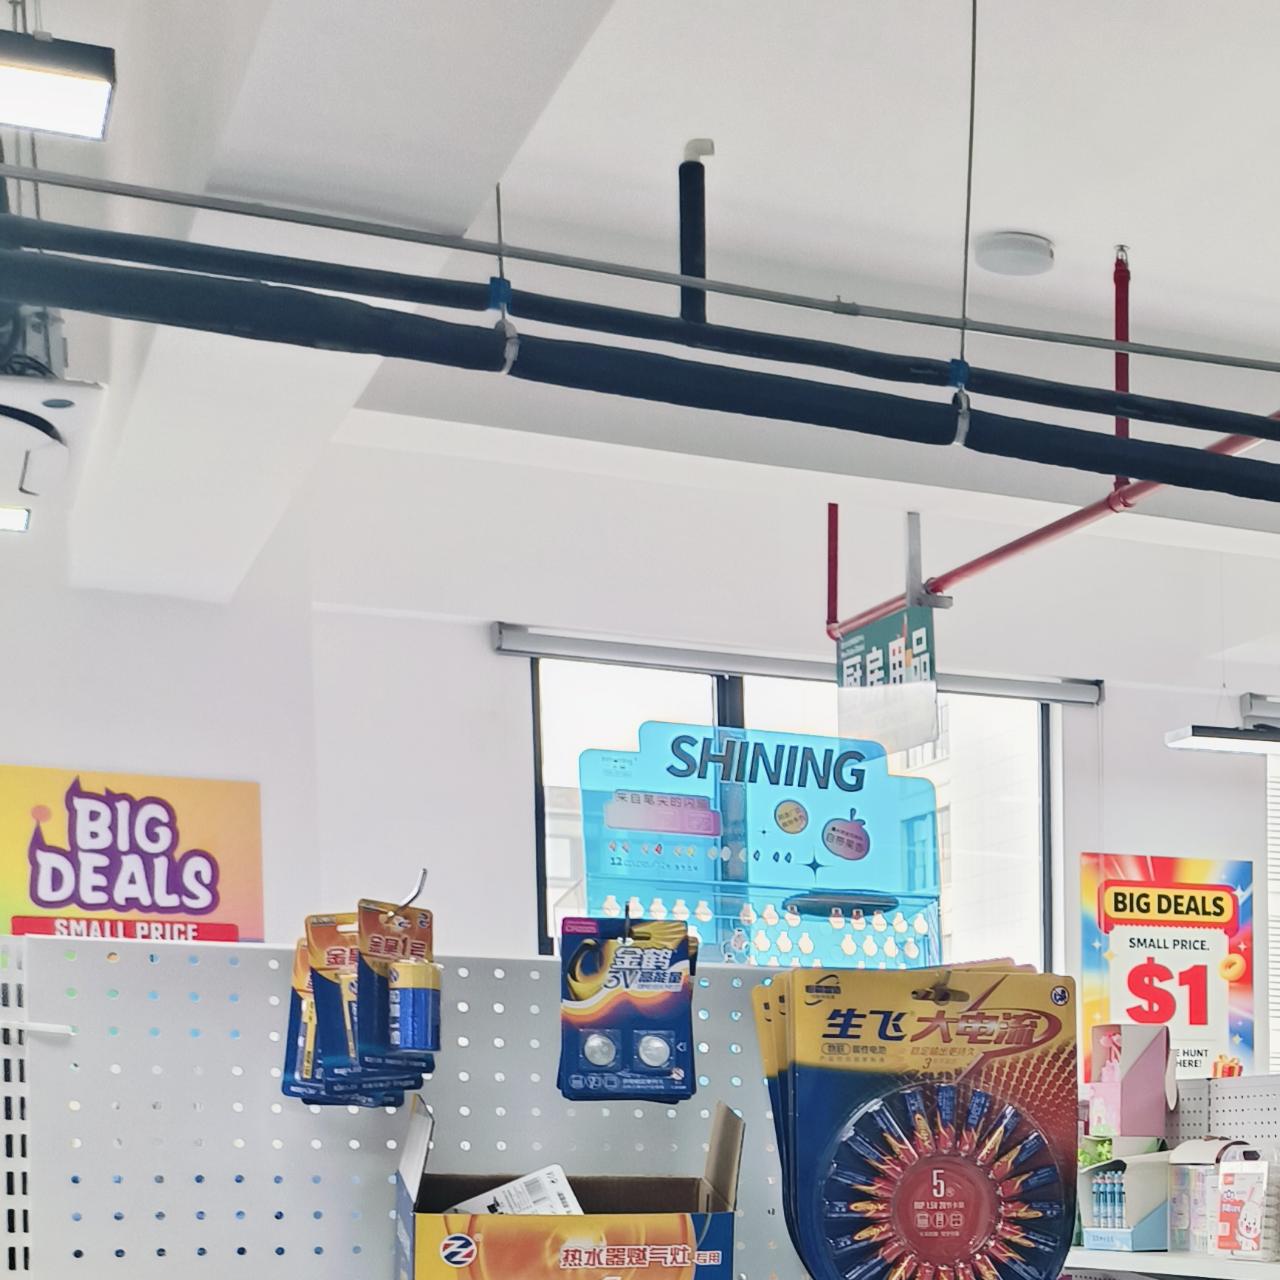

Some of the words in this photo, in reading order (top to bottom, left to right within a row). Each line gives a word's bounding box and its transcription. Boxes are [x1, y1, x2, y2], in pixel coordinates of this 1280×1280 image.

[666, 735, 866, 792] SHINING
[72, 796, 173, 854] BIG
[36, 848, 213, 909] DEALS
[1113, 892, 1151, 913] BIG
[1156, 895, 1225, 917] DEALS
[54, 918, 126, 939] SMALL
[1128, 937, 1170, 950] SMALL
[1126, 956, 1208, 1025] $1
[1182, 1049, 1208, 1057] HUNT
